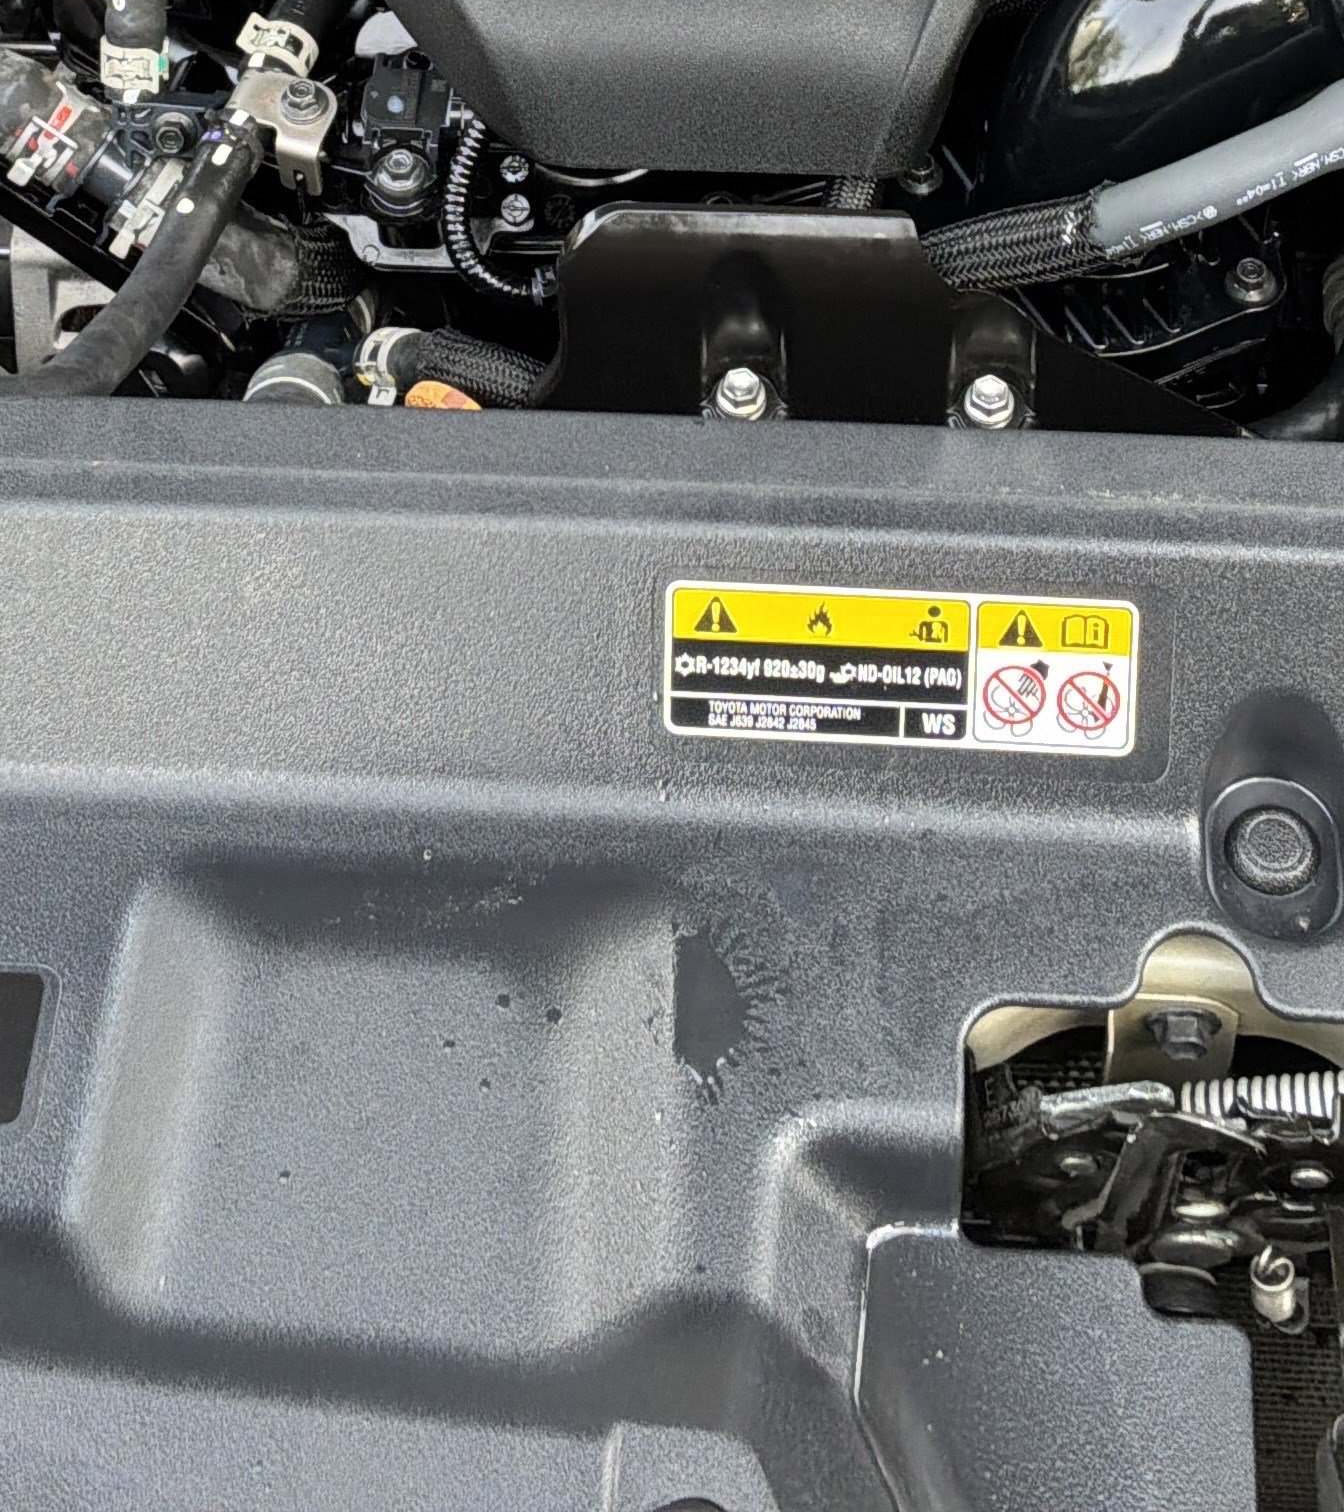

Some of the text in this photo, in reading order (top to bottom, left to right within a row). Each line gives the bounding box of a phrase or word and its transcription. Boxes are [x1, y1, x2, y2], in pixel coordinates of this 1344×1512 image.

[696, 655, 761, 680] R-1234yf
[924, 667, 962, 690] (PAG)
[708, 700, 861, 720] TOYOTA MOTOR CORPORATION
[708, 714, 727, 727] SAE
[922, 714, 956, 736] WS
